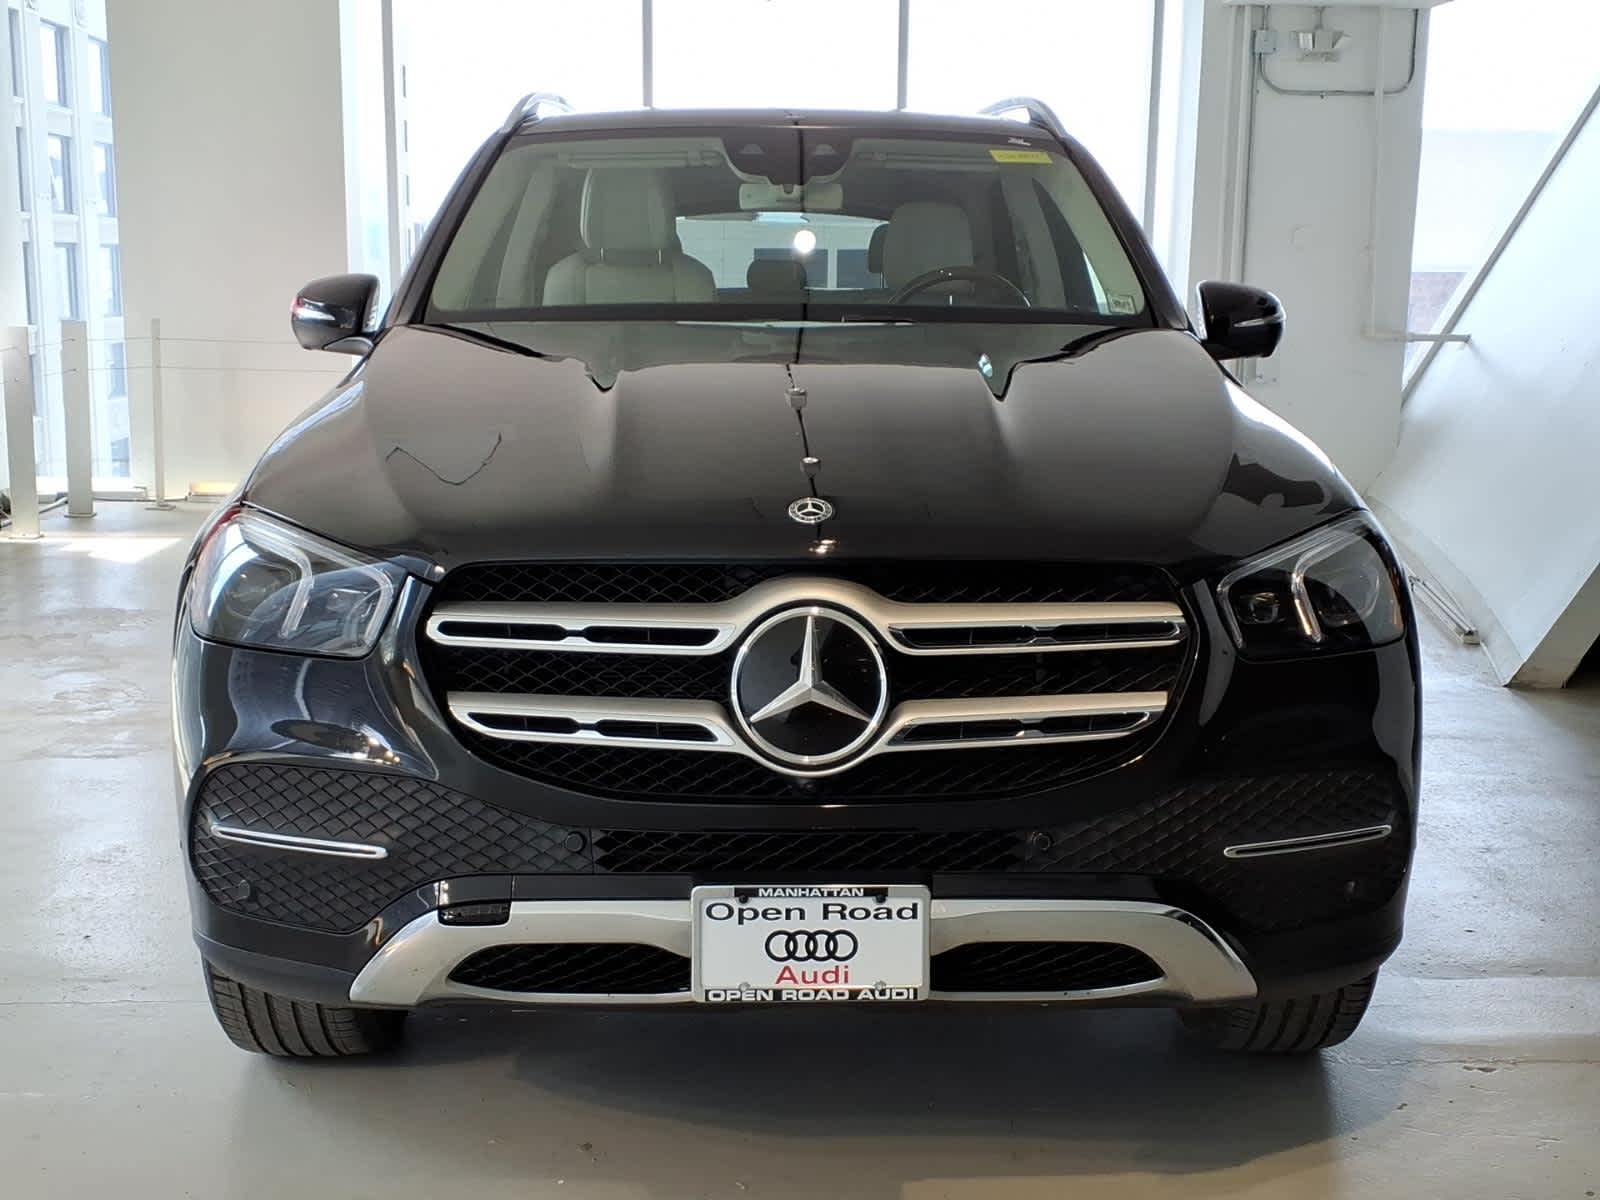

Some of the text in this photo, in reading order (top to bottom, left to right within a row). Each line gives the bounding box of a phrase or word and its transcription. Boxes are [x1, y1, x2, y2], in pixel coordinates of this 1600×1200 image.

[758, 888, 864, 897] MANHATTAN
[705, 902, 918, 925] Open Road
[775, 965, 849, 984] Audi
[708, 988, 914, 1000] OPEN ROAD AUDI
